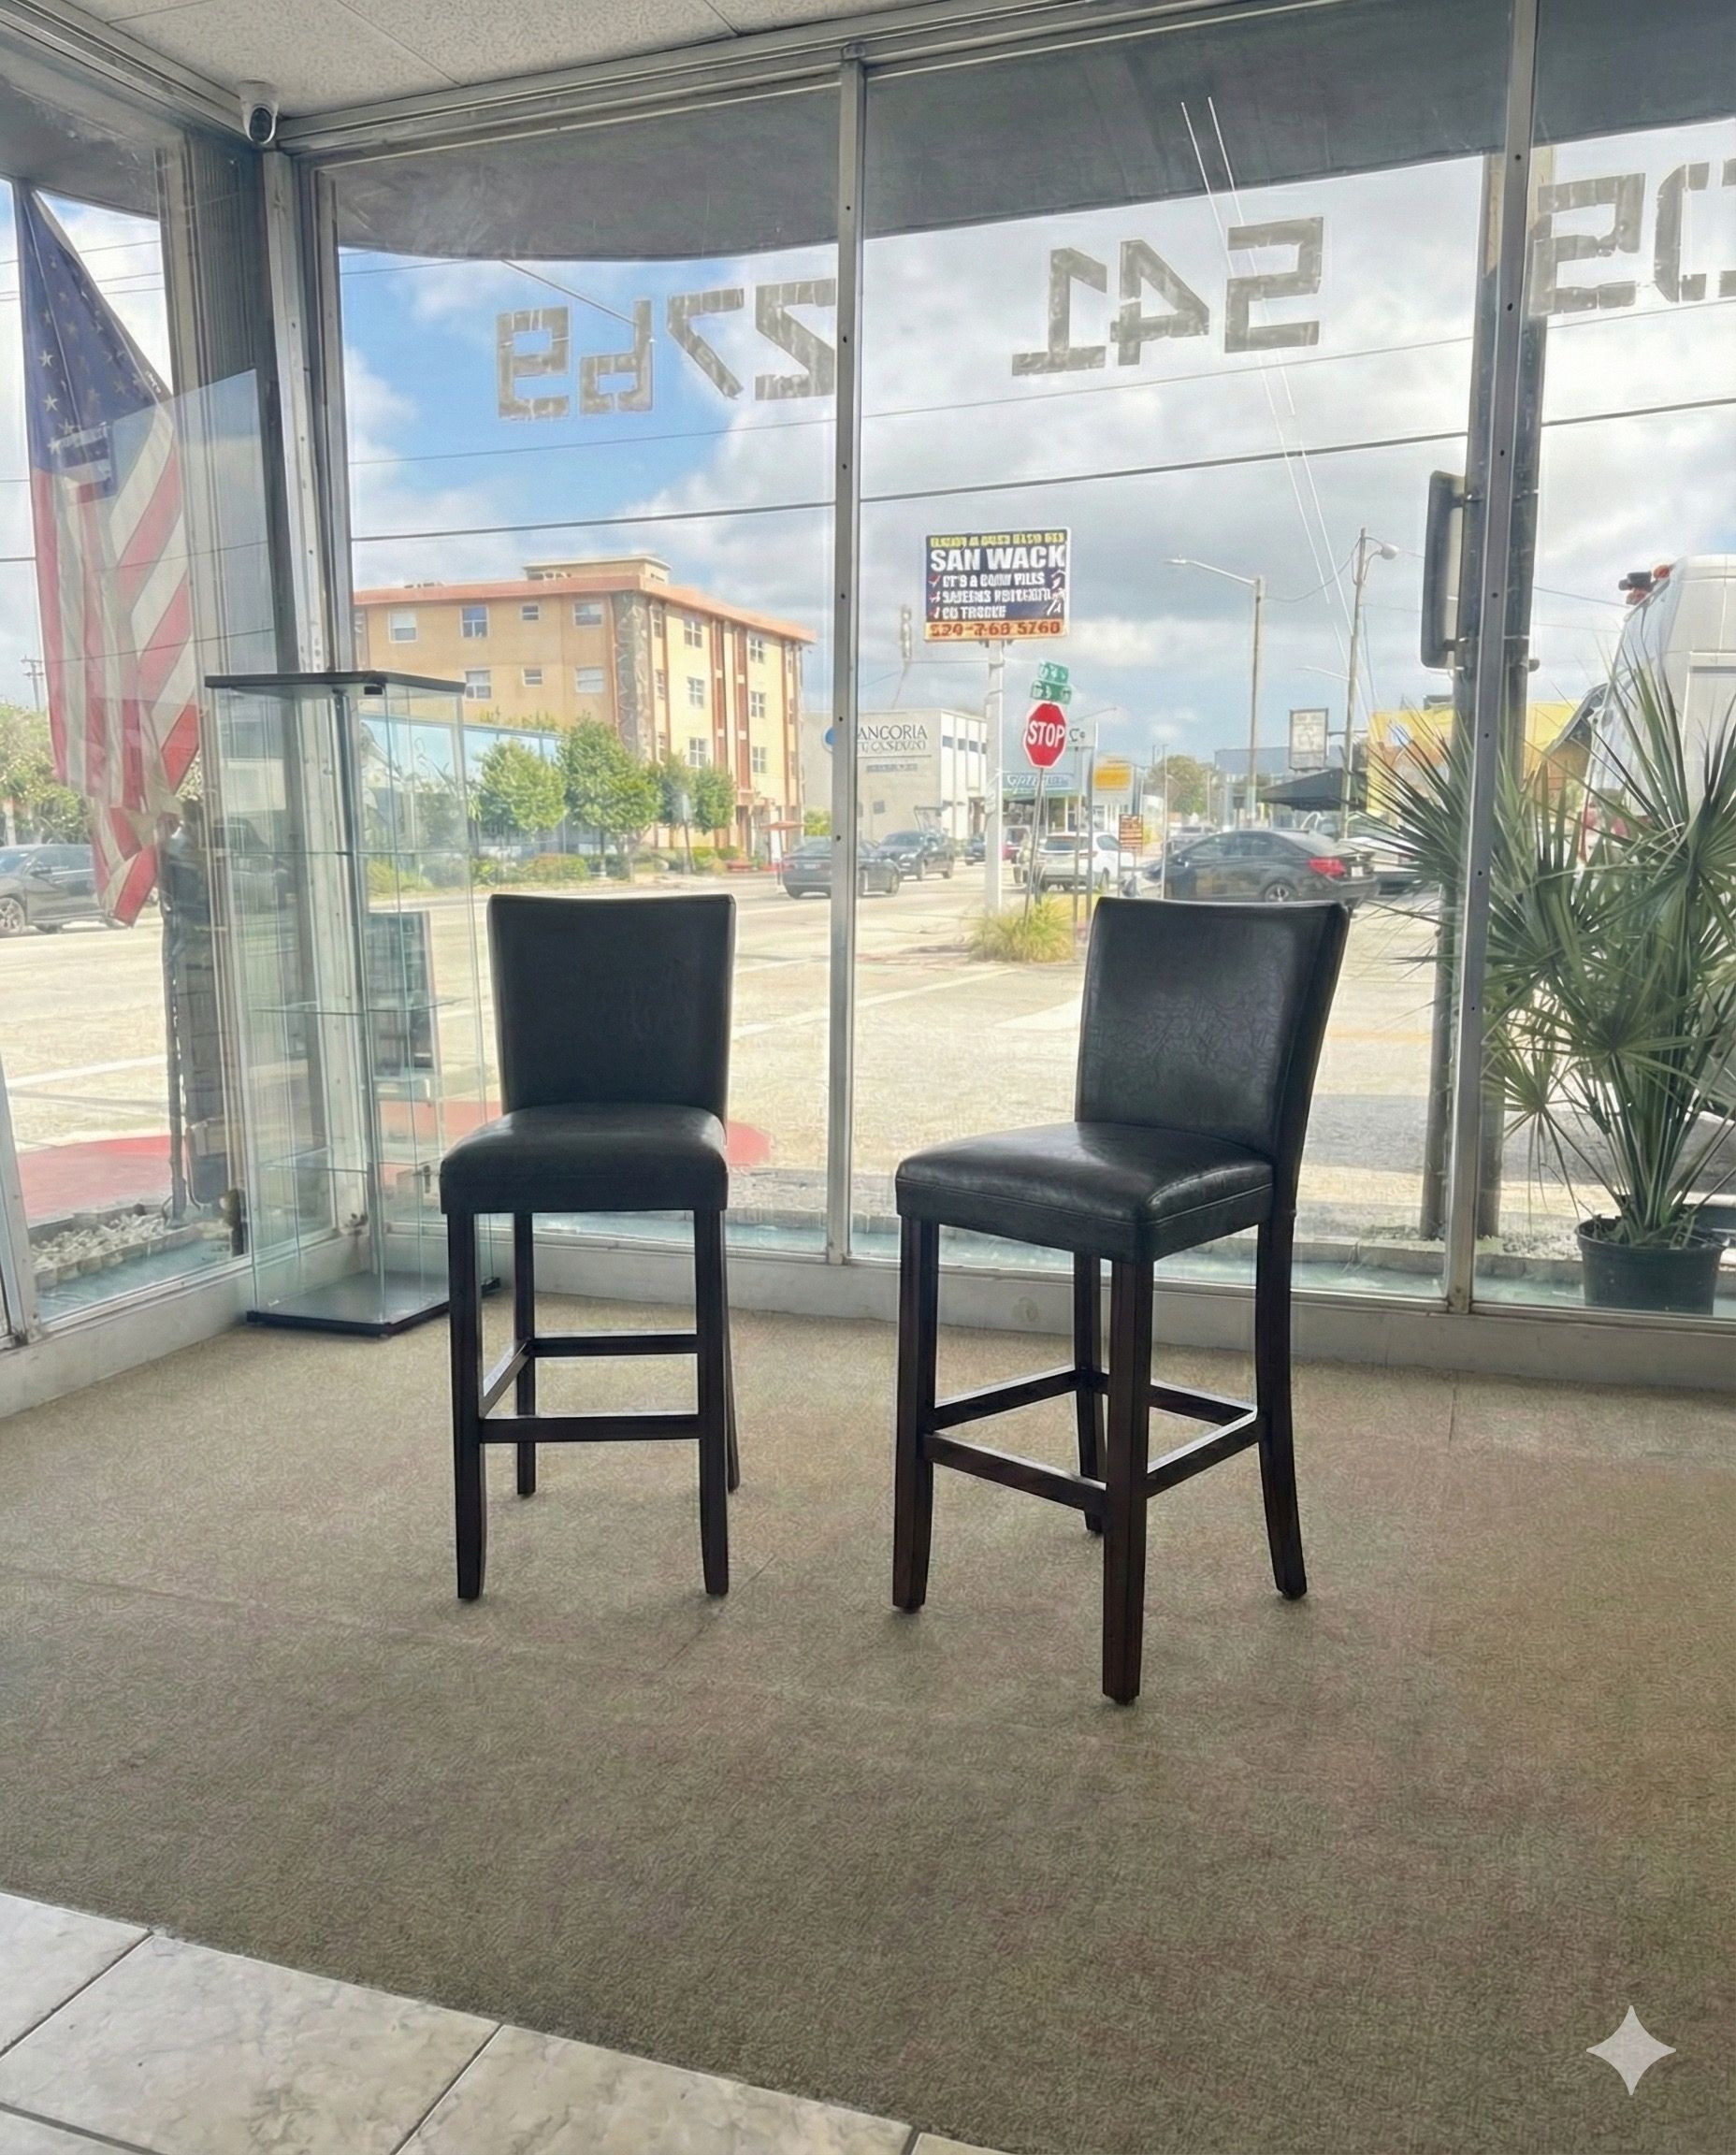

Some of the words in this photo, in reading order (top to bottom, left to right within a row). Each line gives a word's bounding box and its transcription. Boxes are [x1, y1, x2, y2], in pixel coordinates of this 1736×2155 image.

[930, 548, 980, 571] SAN
[986, 545, 1065, 571] WACK
[1028, 720, 1064, 747] STOP
